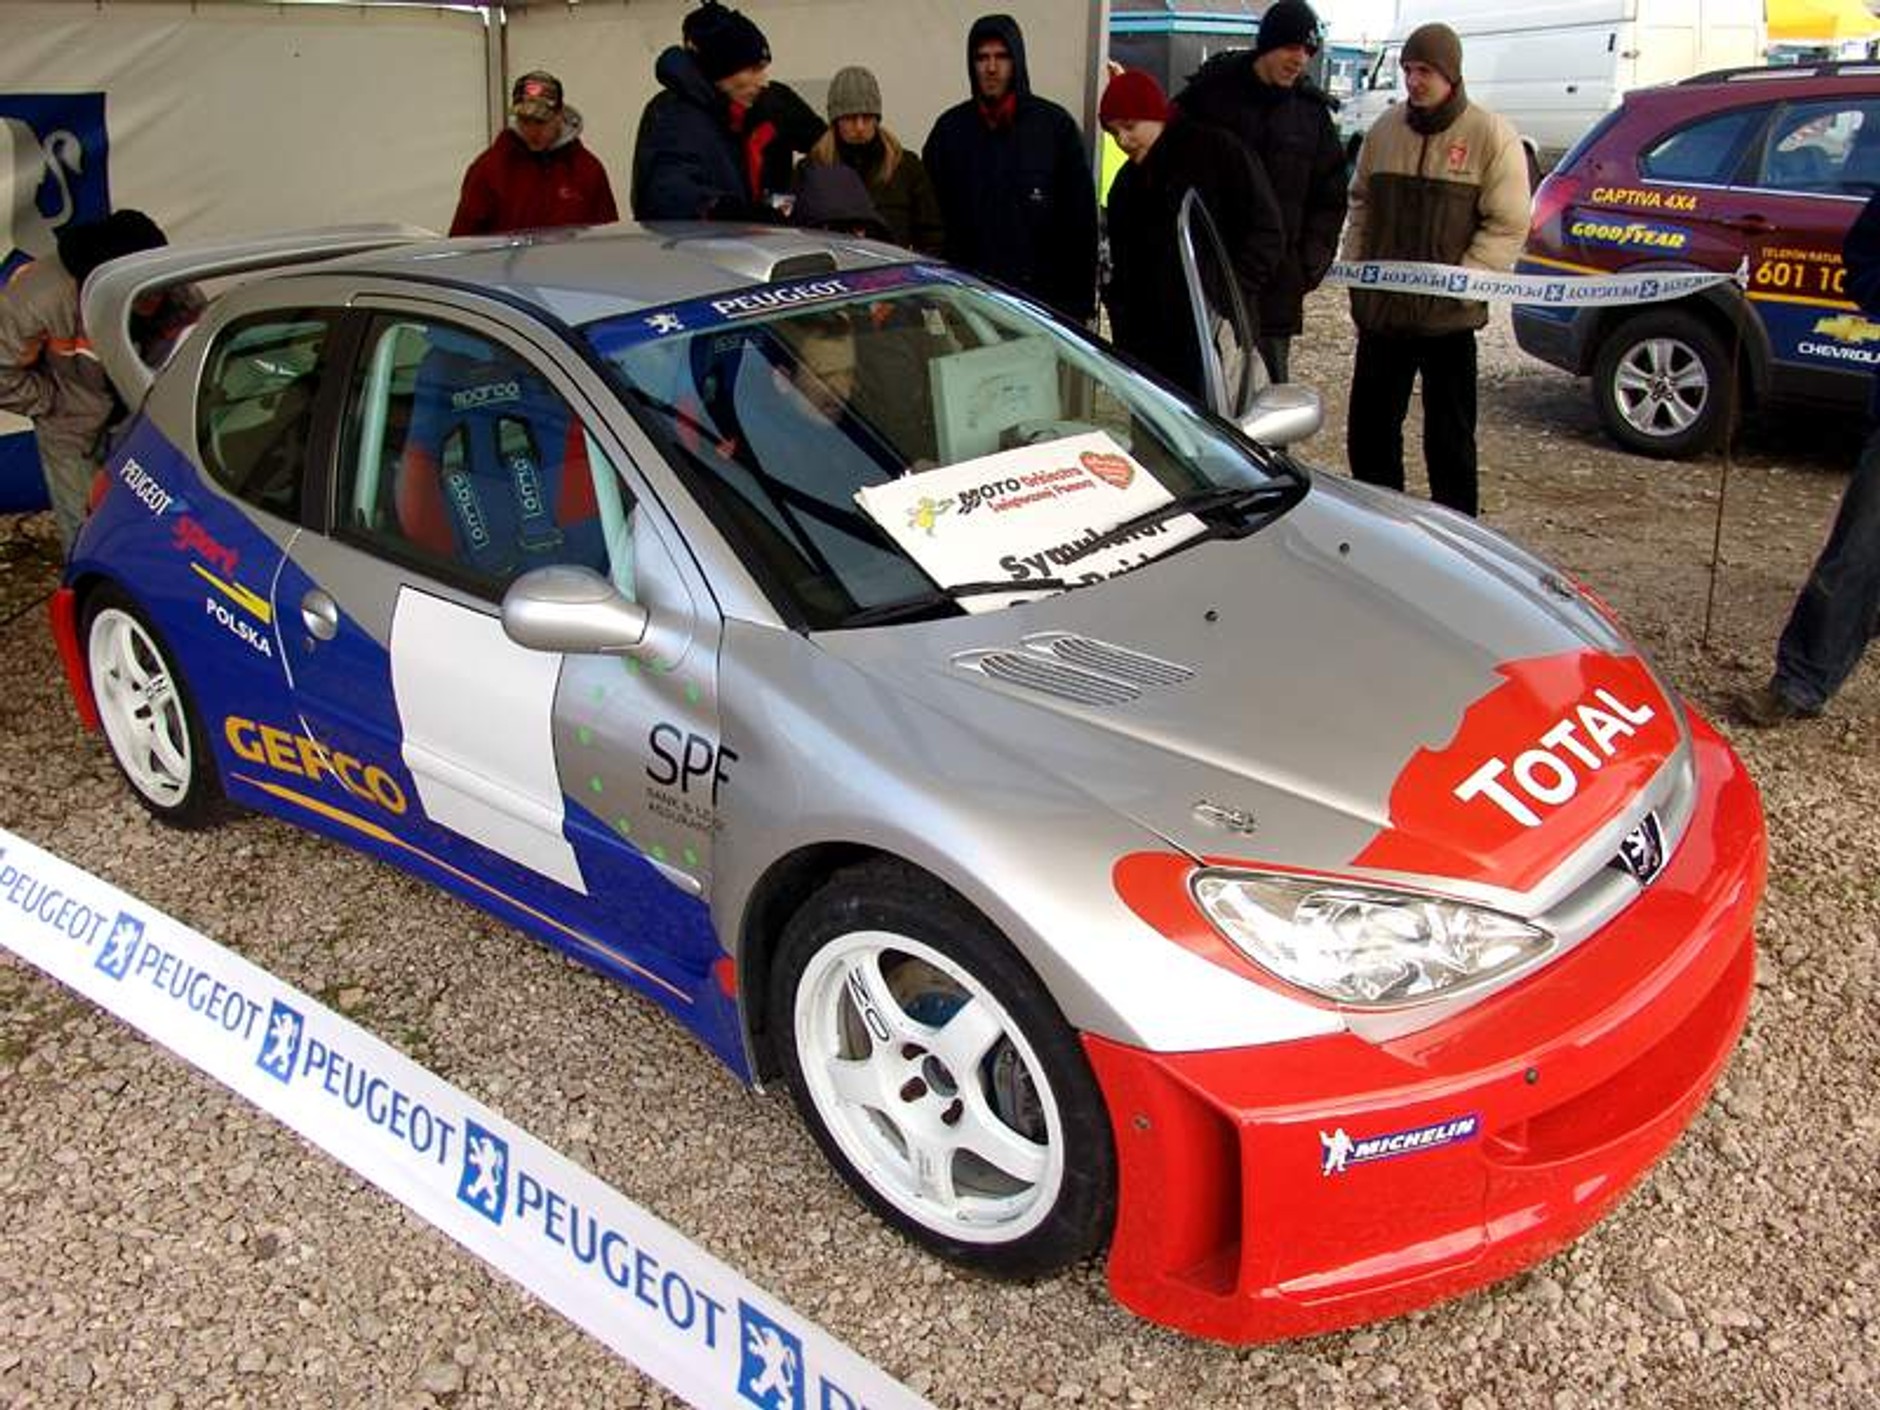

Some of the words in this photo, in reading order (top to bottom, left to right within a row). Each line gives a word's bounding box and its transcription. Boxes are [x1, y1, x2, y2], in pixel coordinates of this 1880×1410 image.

[1591, 187, 1661, 208] CAPTIVA
[1571, 222, 1686, 248] GOODYEAR
[710, 279, 850, 315] PEUGEOT
[1755, 260, 1805, 289] 601
[1797, 341, 1880, 363] CHEVROL
[119, 458, 173, 516] PEUGEOT
[205, 597, 273, 658] POLSKA
[225, 715, 408, 815] GEFCO
[646, 722, 739, 807] SPF
[1452, 688, 1656, 828] TOTAL
[0, 864, 109, 946] PEUGEOT
[137, 942, 263, 1041] PEUGEOT
[302, 1038, 456, 1166] PEUGEOT
[1355, 1118, 1475, 1158] MICHELIN
[515, 1171, 726, 1350] PEUGEOT
